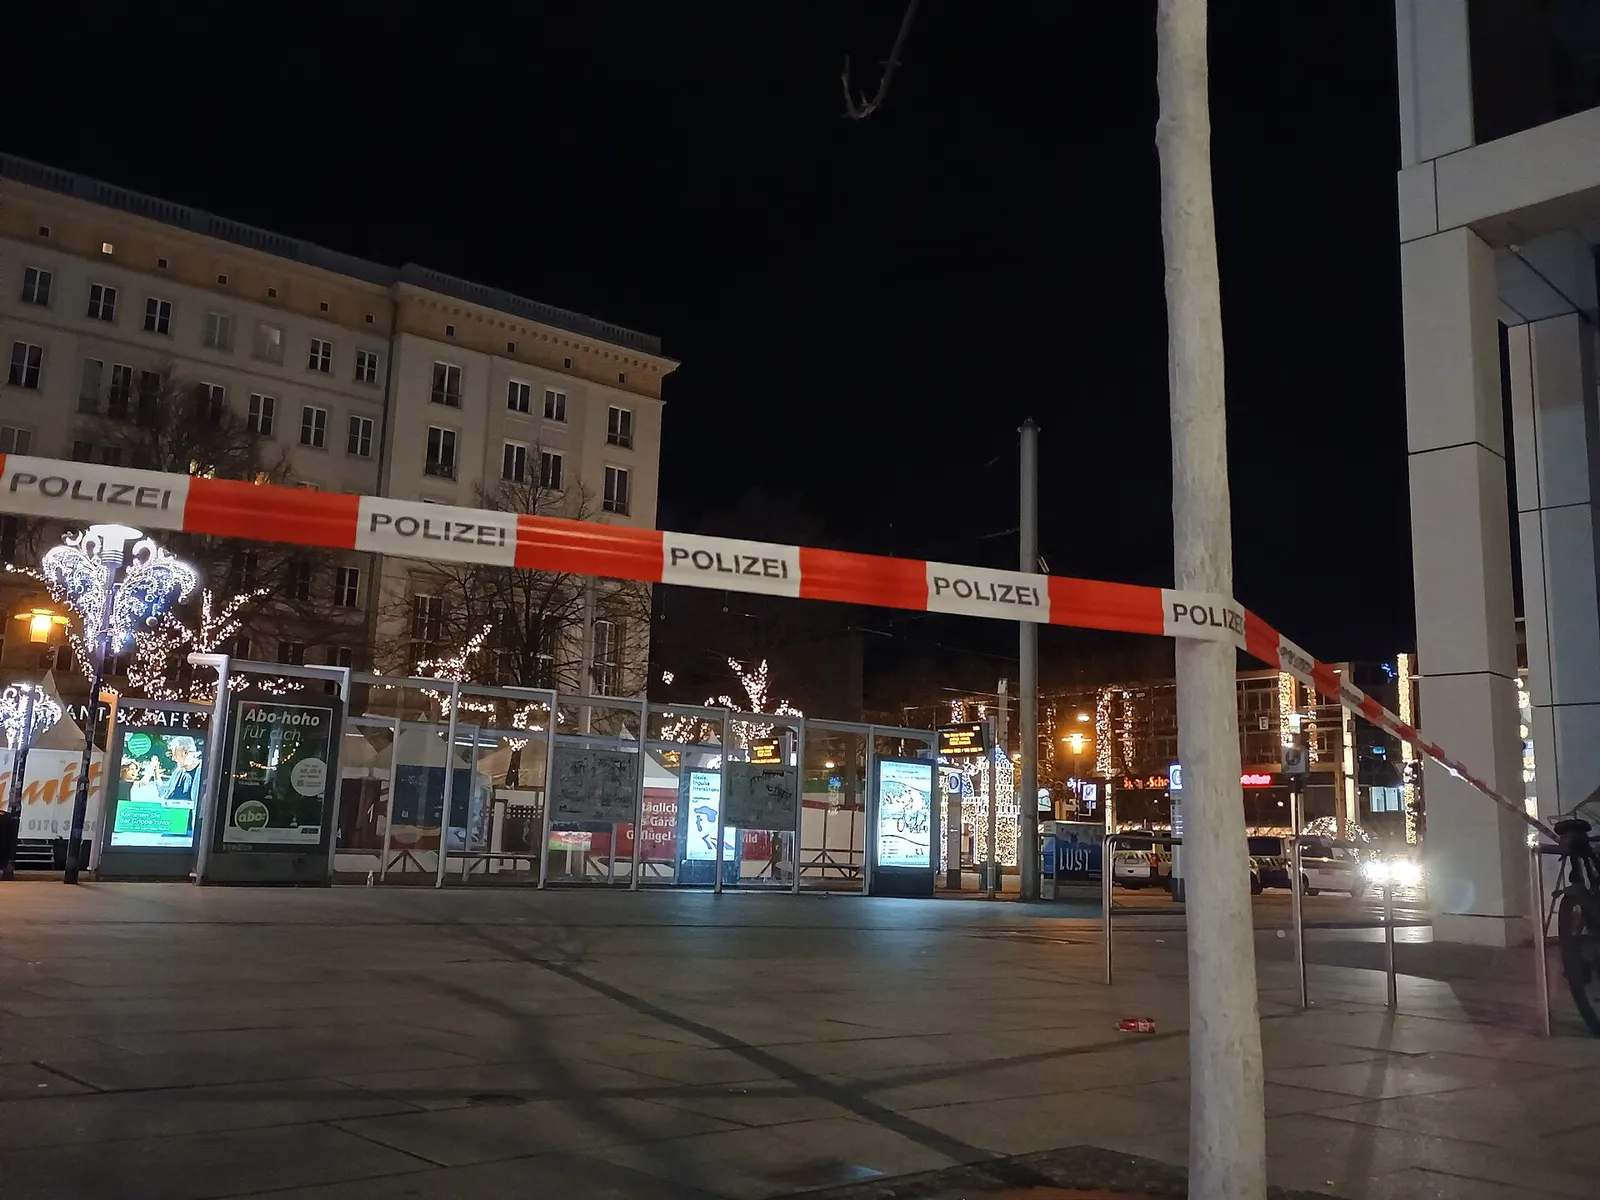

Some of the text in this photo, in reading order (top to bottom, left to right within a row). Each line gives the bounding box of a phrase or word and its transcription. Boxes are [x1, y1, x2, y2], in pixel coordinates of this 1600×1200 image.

[9, 472, 172, 511] POLIZEI
[369, 512, 506, 548] POLIZEI
[669, 546, 789, 579] POLIZEI
[933, 575, 1040, 607] POLIZEI
[1172, 602, 1244, 636] POLIZEI
[66, 703, 107, 722] ANT
[244, 708, 320, 727] Abo-hoho
[242, 724, 267, 741] für
[641, 801, 678, 815] täglich
[649, 815, 678, 827] Gard
[626, 830, 671, 844] Gflügel
